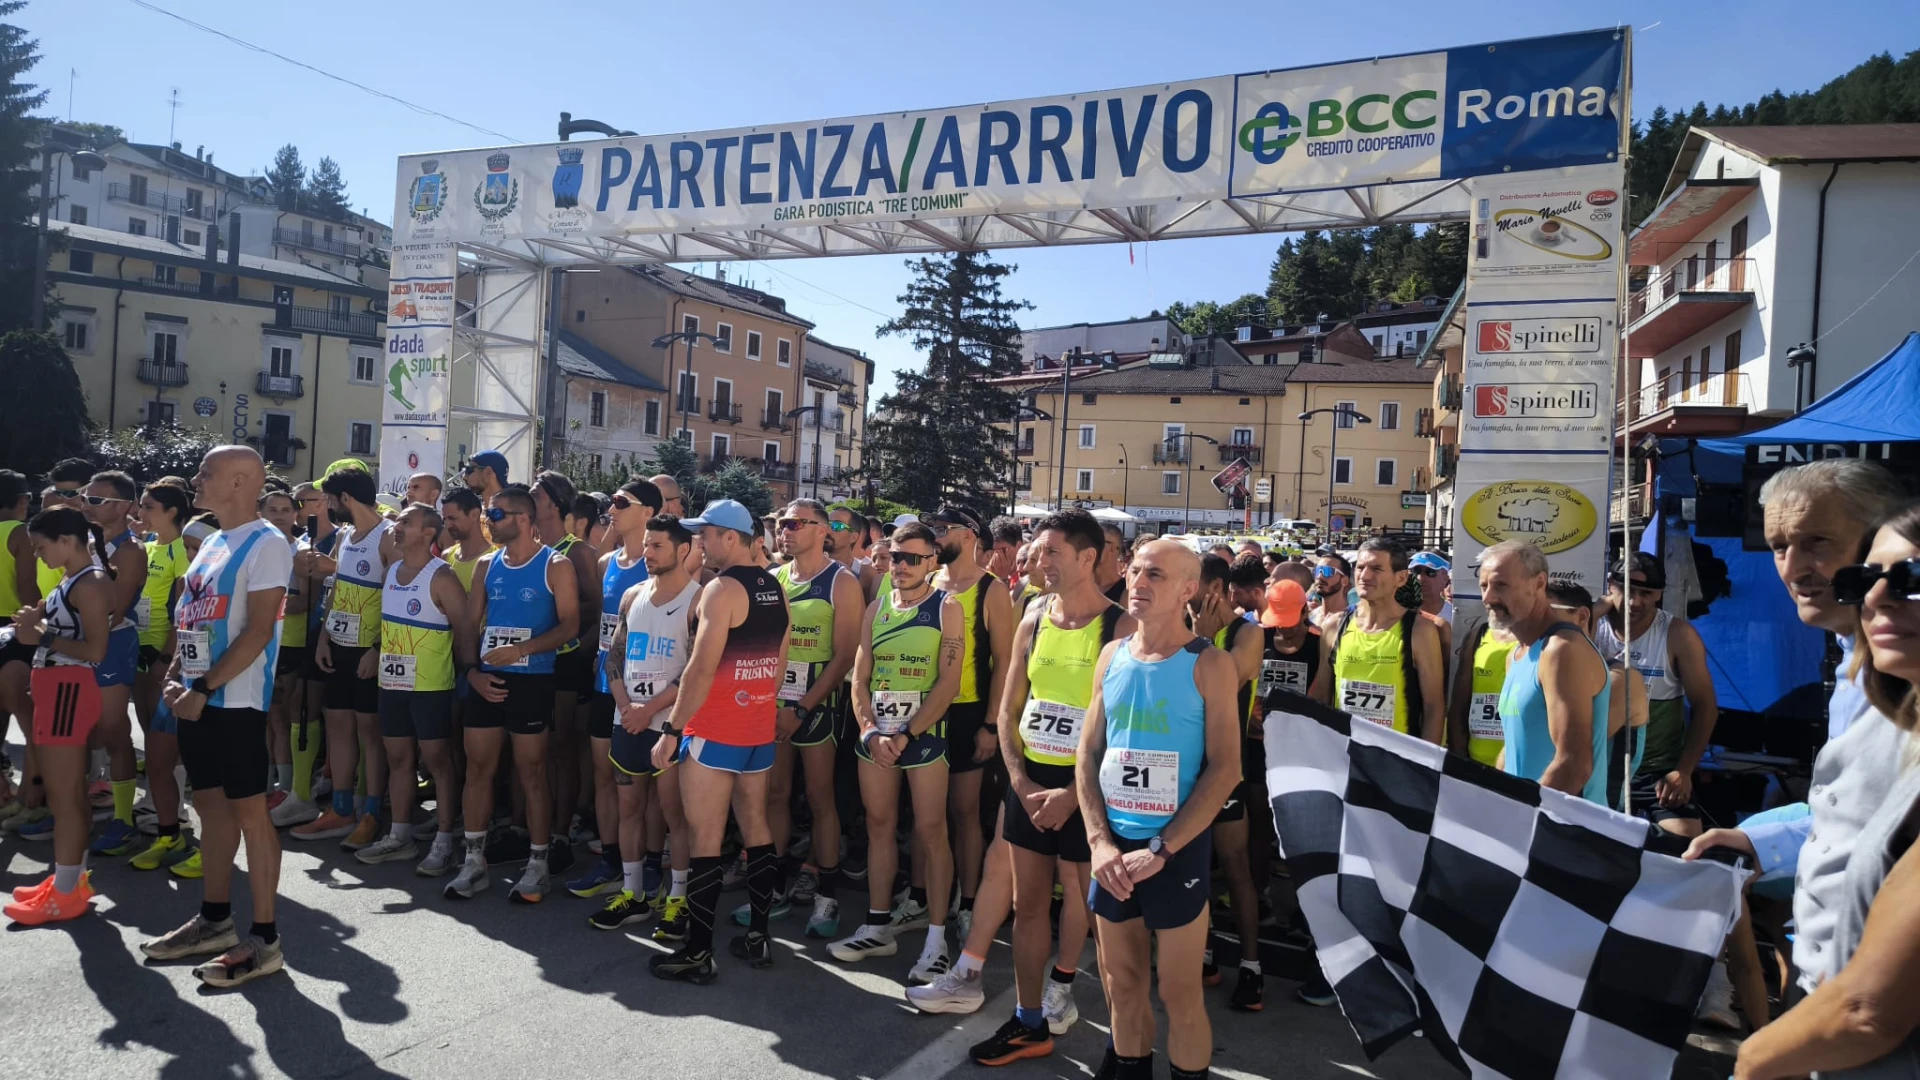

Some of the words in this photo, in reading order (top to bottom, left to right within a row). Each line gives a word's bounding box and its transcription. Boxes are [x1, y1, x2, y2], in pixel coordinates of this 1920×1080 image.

[1307, 89, 1437, 137] BCC
[1457, 86, 1605, 128] Roma
[596, 89, 1213, 212] PARTENZA/ARRIVO
[1306, 139, 1353, 157] CREDITO
[1357, 133, 1435, 153] COOPERATIVO
[1500, 192, 1541, 201] Distribuzione
[1542, 189, 1582, 198] Automatico
[774, 202, 805, 221] GARA
[808, 199, 875, 217] PODISTICA
[1539, 200, 1582, 219] Novelli
[1496, 215, 1534, 232] Mario
[389, 333, 424, 353] dada
[410, 354, 448, 377] sport
[1468, 360, 1483, 369] Una
[1519, 359, 1527, 367] la
[1465, 424, 1480, 432] Una
[1516, 424, 1523, 432] la
[333, 620, 348, 633] 27
[602, 622, 617, 637] 37
[385, 664, 405, 676] 40
[786, 671, 797, 684] 3
[1264, 670, 1299, 684] 532
[634, 682, 654, 696] 41
[1344, 690, 1387, 710] 277
[876, 702, 912, 717] 547
[1028, 713, 1074, 736] 276
[1122, 765, 1149, 788] 21
[1107, 797, 1133, 808] ANGELO
[1135, 801, 1175, 812] MENALE
